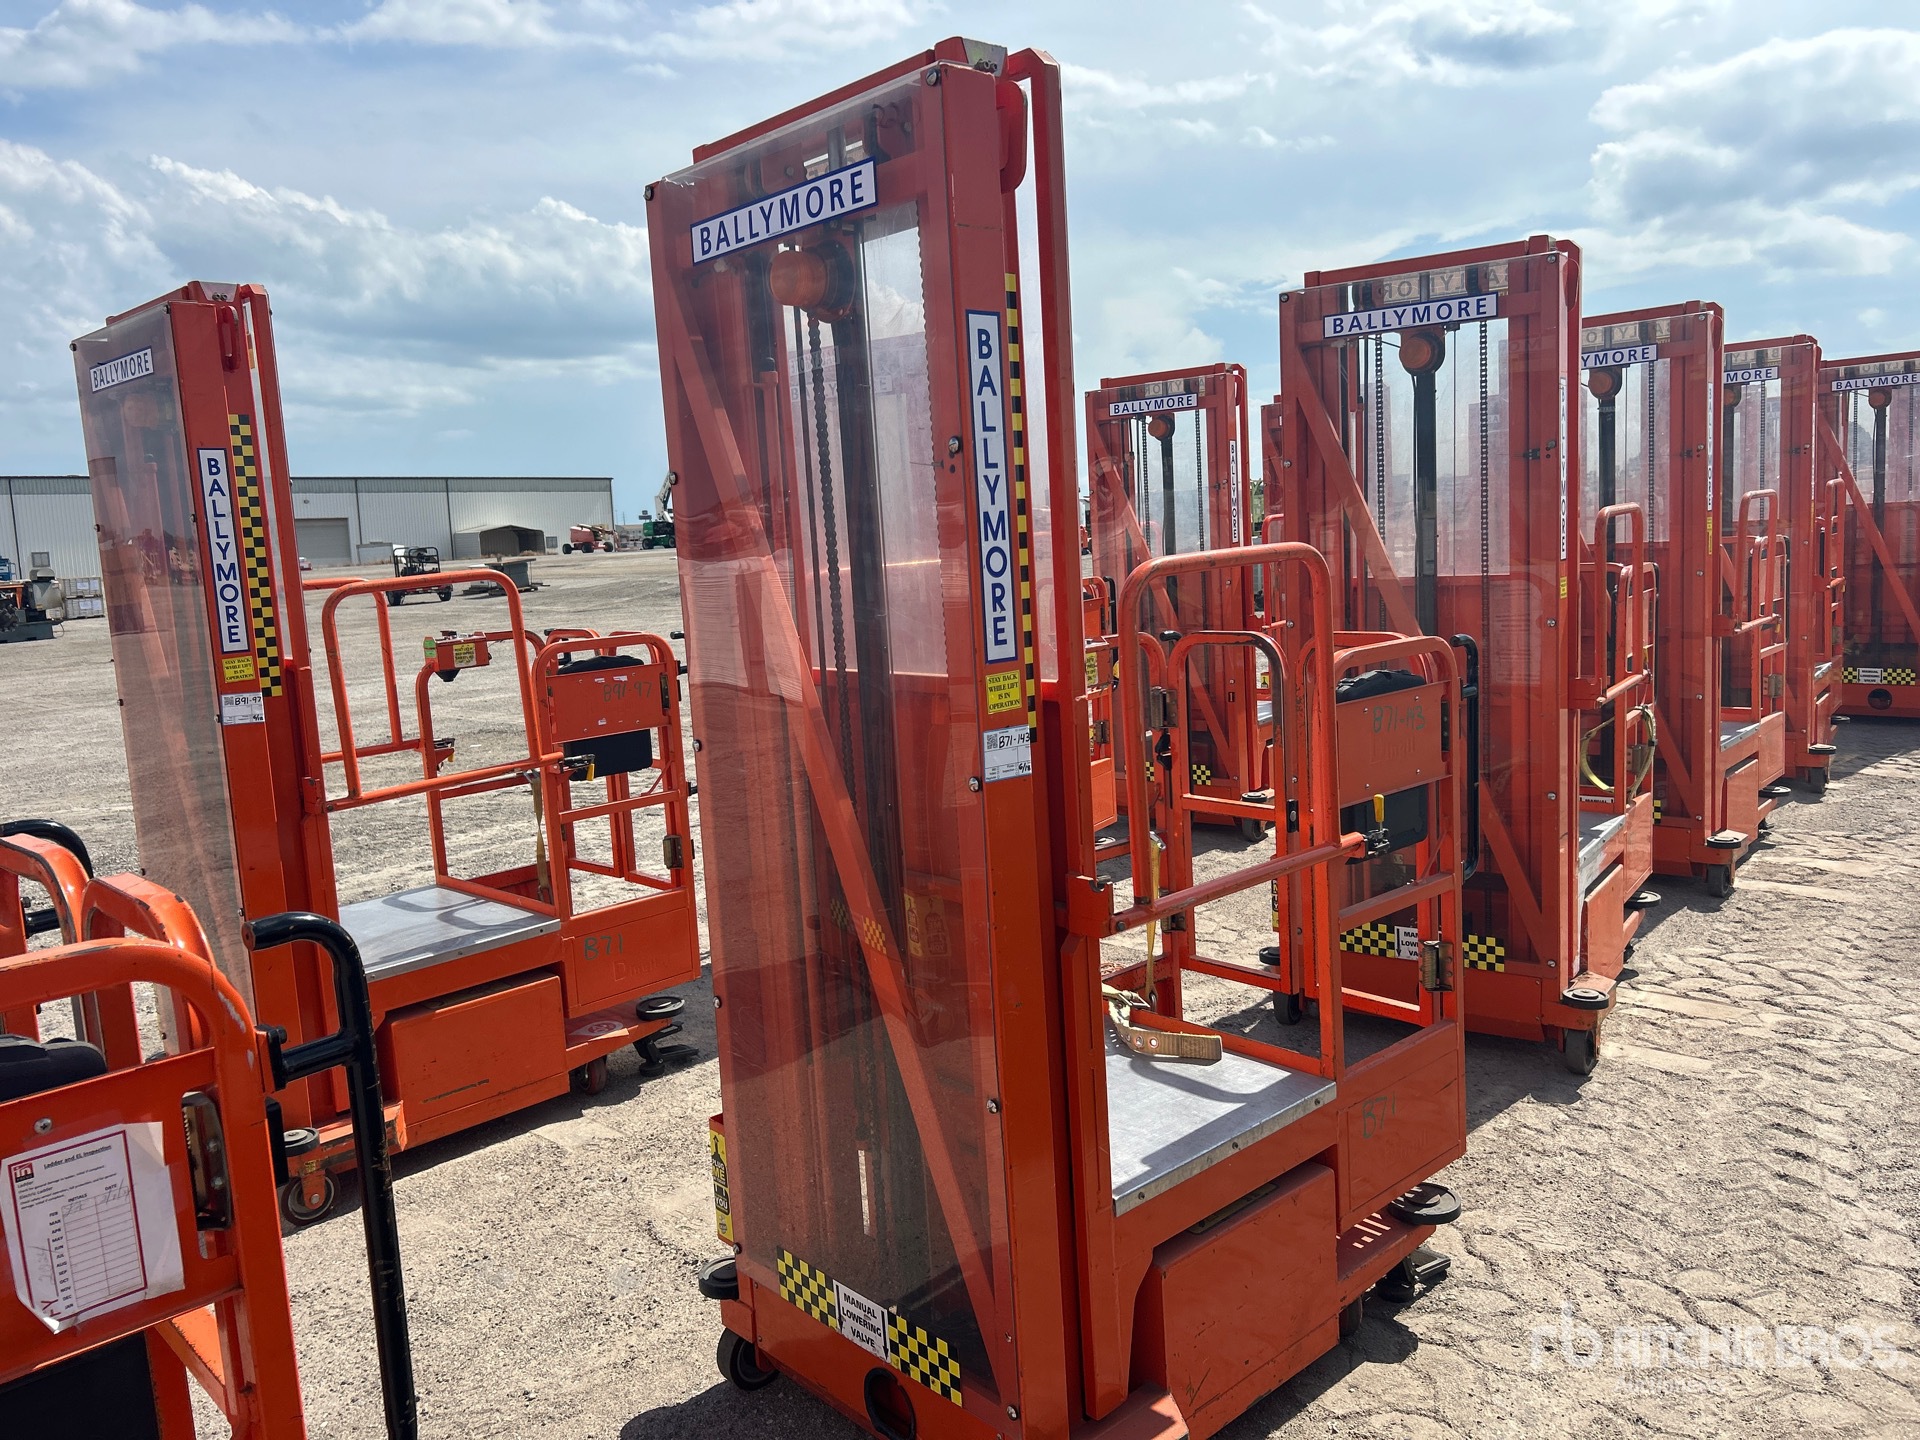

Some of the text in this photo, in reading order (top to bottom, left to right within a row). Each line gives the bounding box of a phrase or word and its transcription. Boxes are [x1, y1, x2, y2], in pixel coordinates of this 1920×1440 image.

[700, 170, 864, 256] BALLYMORE
[1333, 298, 1487, 334] BALLYMORE
[1582, 347, 1650, 367] YMORE
[93, 352, 149, 388] BALLYMORE
[1836, 374, 1918, 390] BALLYMORE
[1113, 396, 1193, 414] BALLYMORE
[977, 328, 1007, 646] BALLYMORE
[1230, 444, 1238, 540] BALLYMORE
[207, 457, 241, 643] BALLYMORE
[988, 673, 1018, 684] STAY BACK
[988, 681, 1019, 693] WHILE LIFT
[235, 696, 262, 706] B91-97
[989, 698, 1021, 711] OPERATION
[998, 732, 1030, 749] B71-143
[584, 933, 623, 961] B71
[1362, 1090, 1396, 1139] B71
[68, 1193, 88, 1203] INITIALS
[843, 1292, 877, 1320] MANUAL
[842, 1306, 882, 1338] LOWERING
[850, 1325, 876, 1348] VALVE
